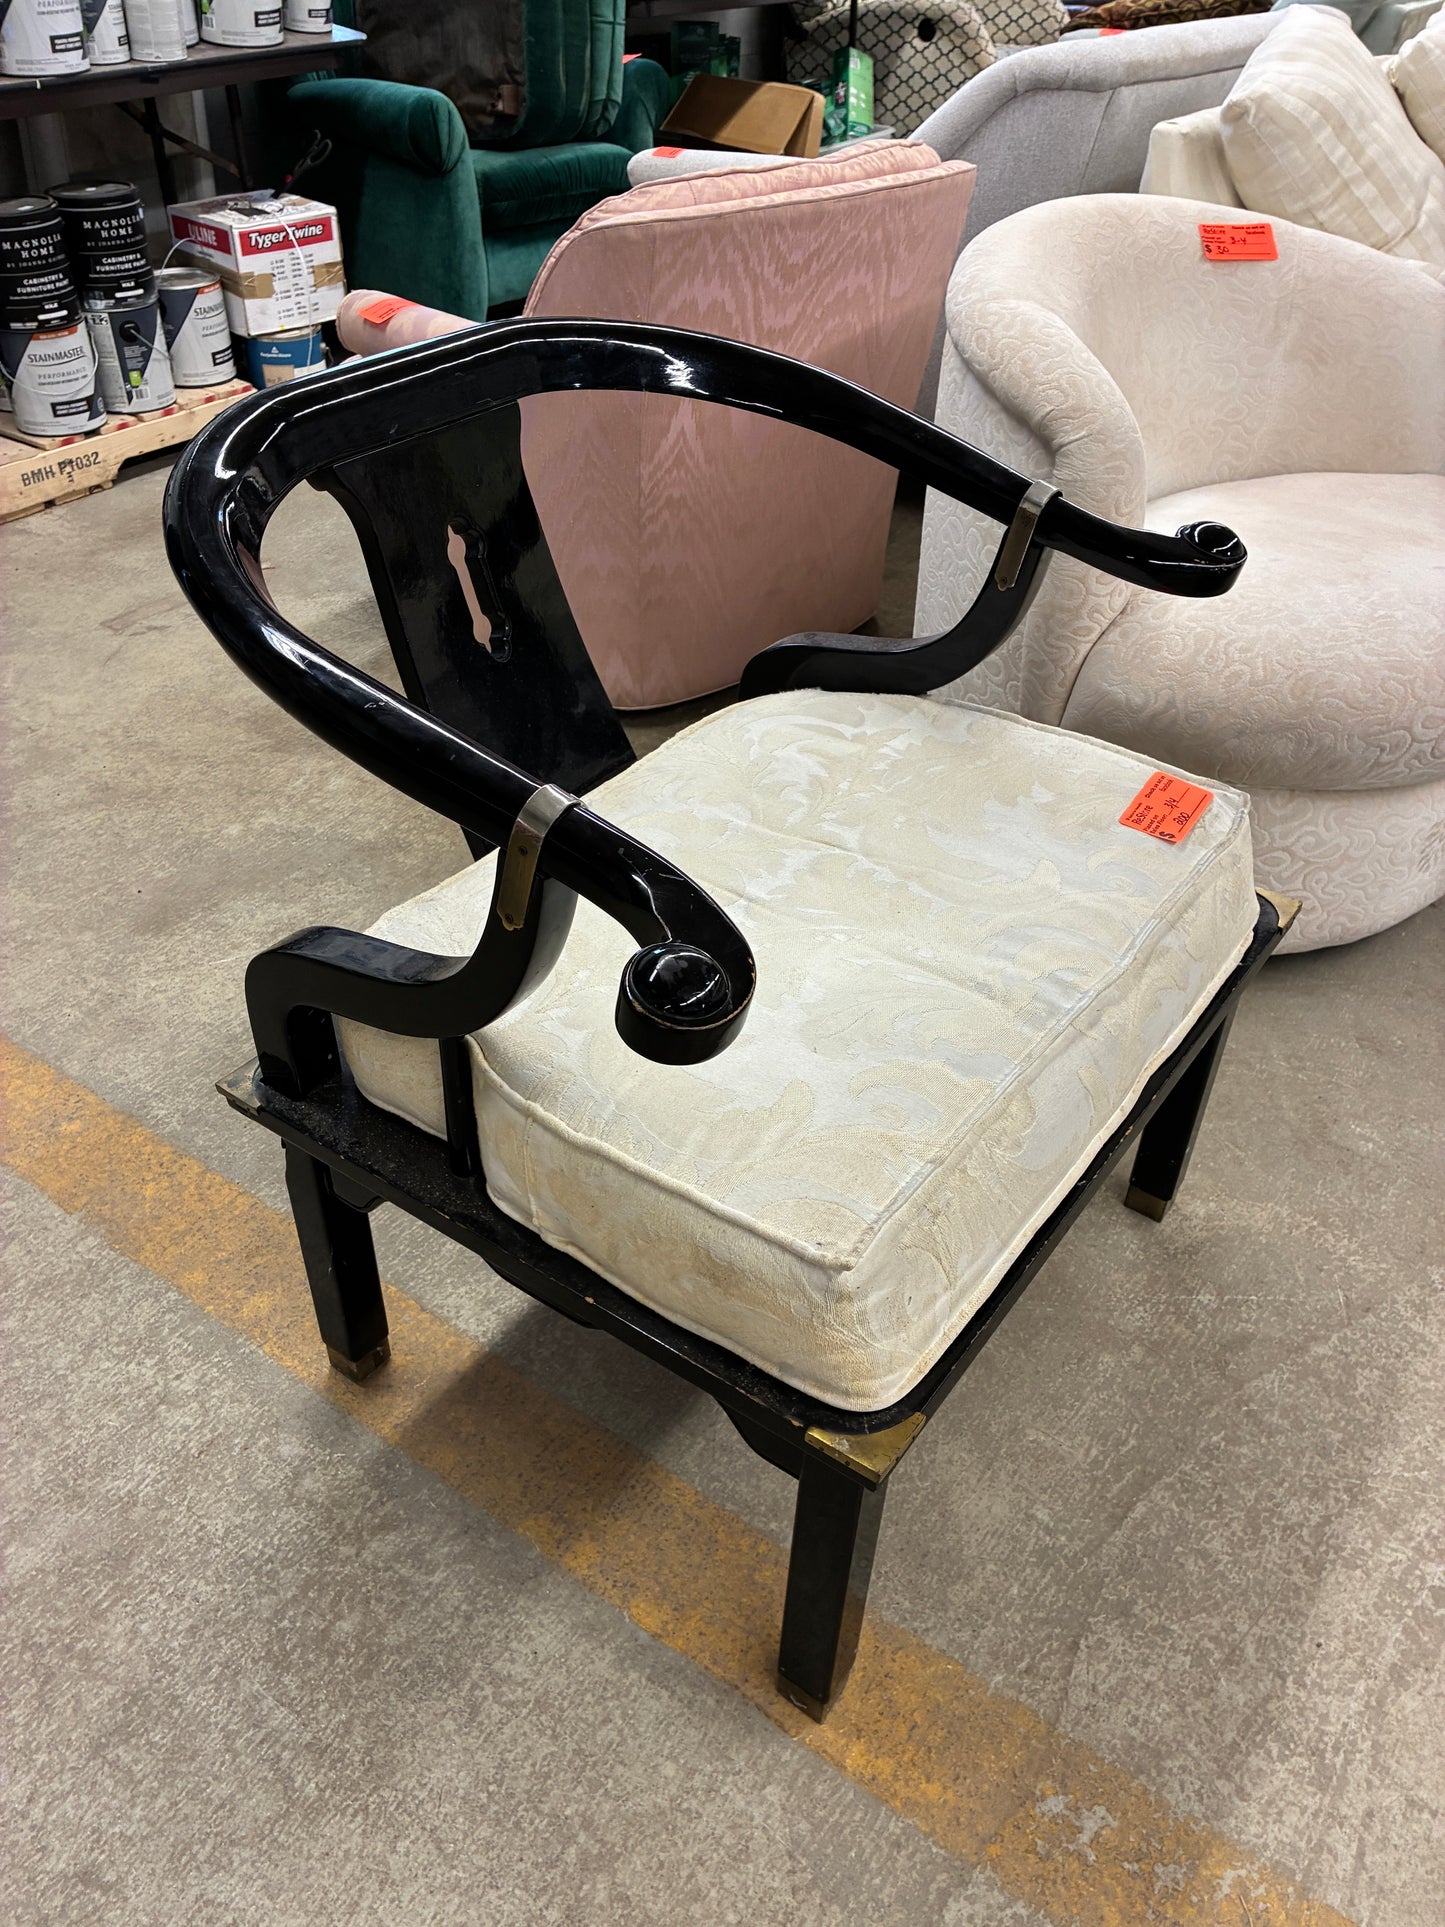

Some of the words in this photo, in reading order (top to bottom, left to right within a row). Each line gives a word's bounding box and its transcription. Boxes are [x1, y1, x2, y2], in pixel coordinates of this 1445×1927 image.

[101, 226, 133, 238] HOME
[187, 222, 218, 247] ULINE
[248, 230, 287, 250] Tyger
[288, 223, 324, 241] Twine
[20, 245, 54, 259] HOME
[27, 345, 85, 363] STAINMASTER
[21, 465, 56, 487] BMH
[1159, 831, 1176, 839] $
